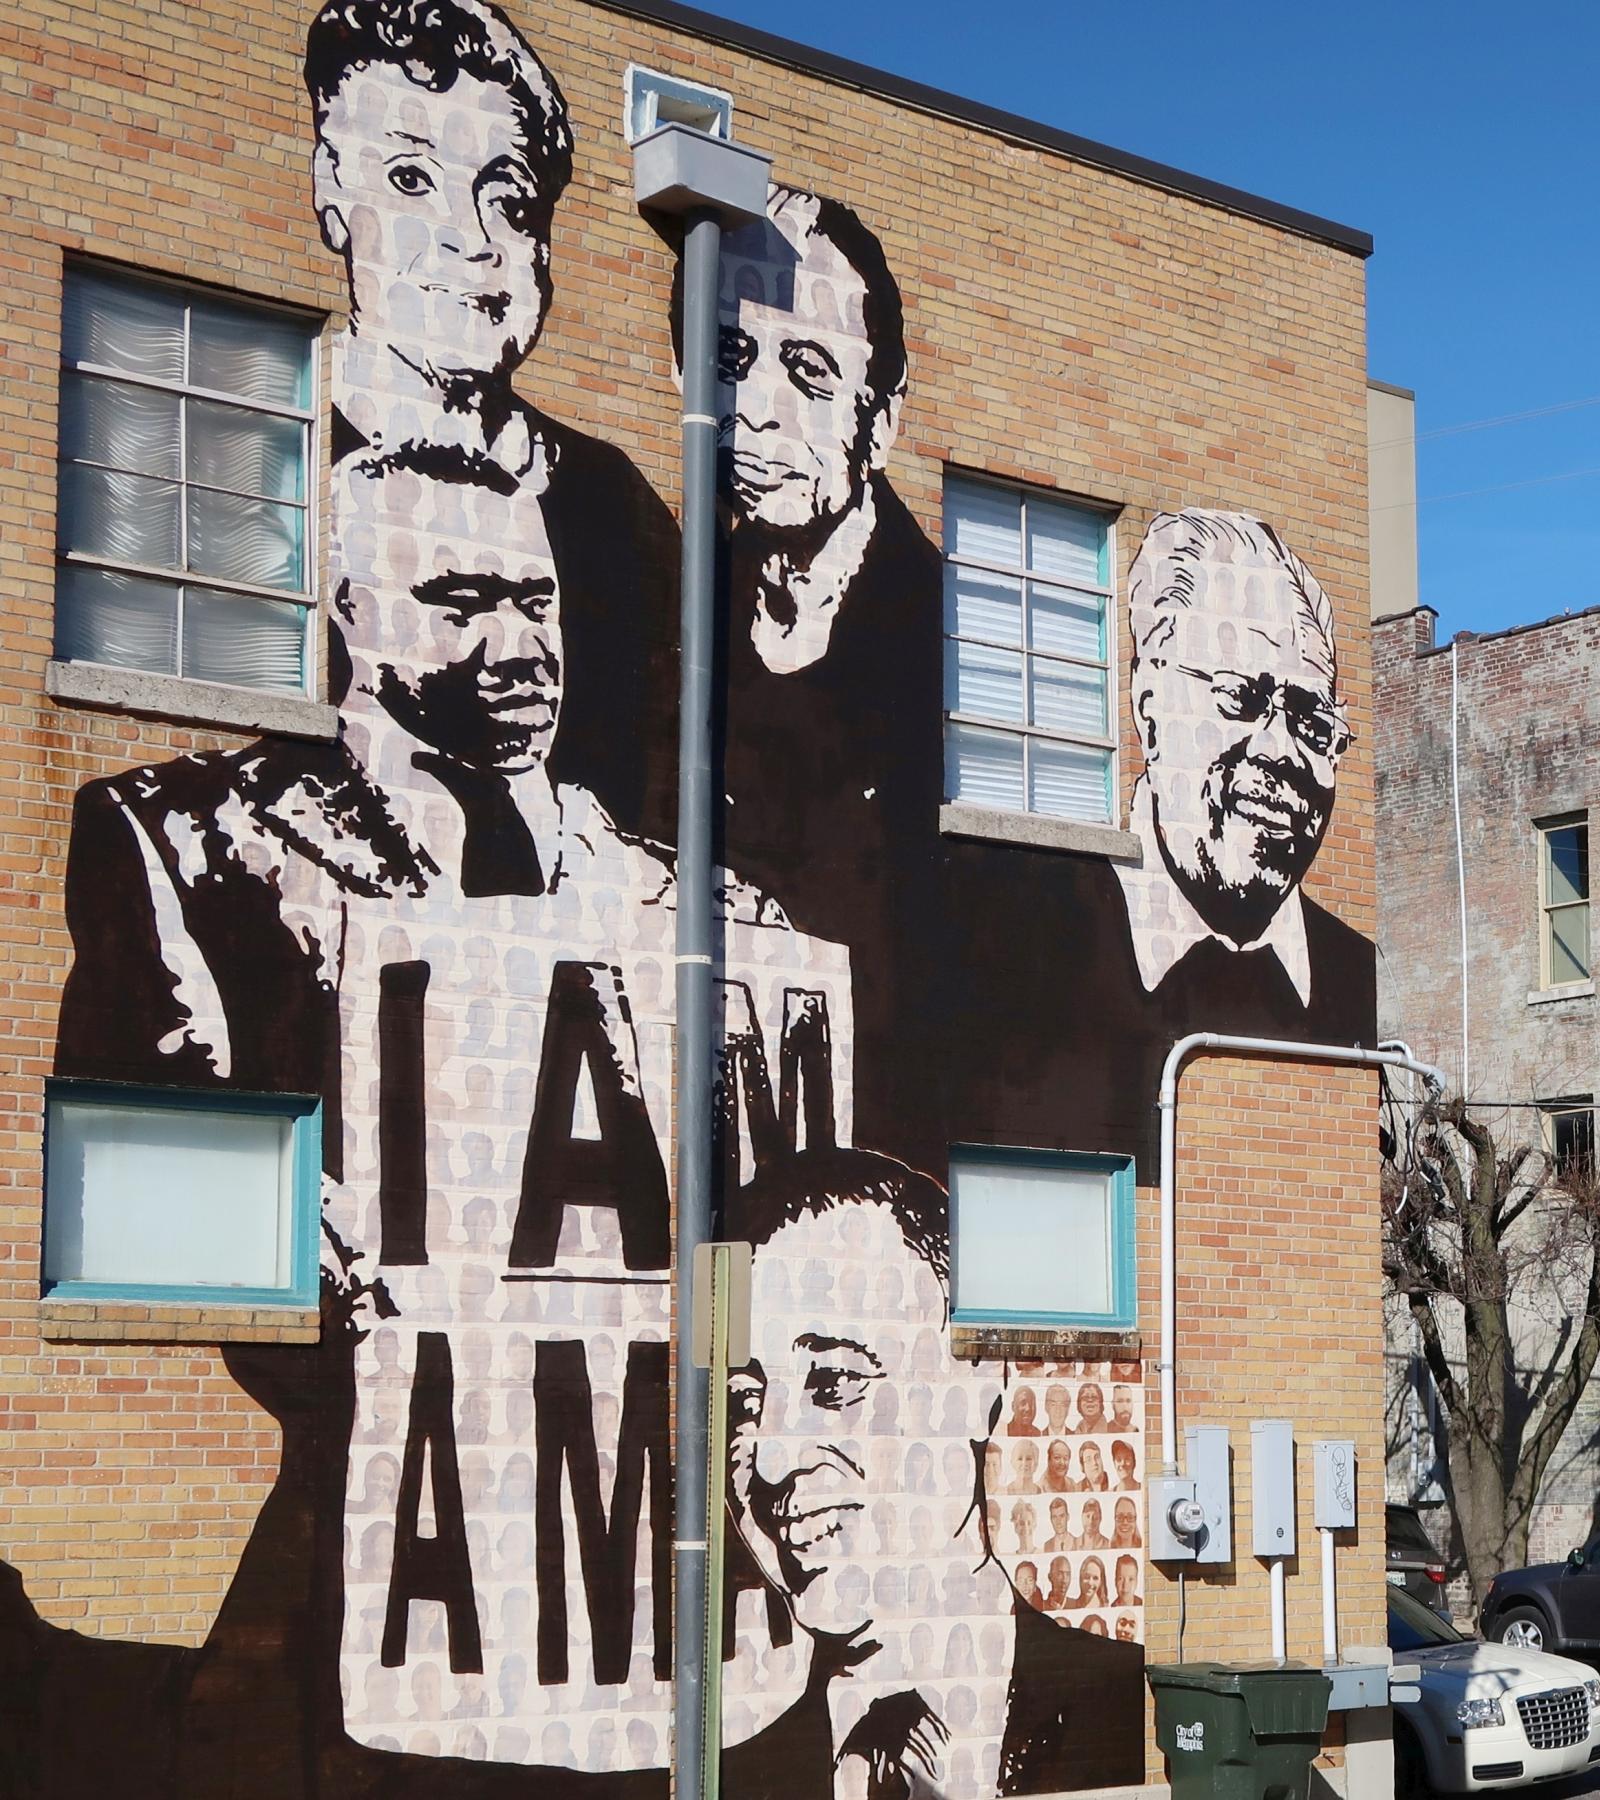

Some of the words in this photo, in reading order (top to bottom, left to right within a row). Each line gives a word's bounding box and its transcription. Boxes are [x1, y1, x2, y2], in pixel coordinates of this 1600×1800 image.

[379, 960, 430, 1266] I
[508, 961, 835, 1270] AM
[381, 1331, 484, 1674] A
